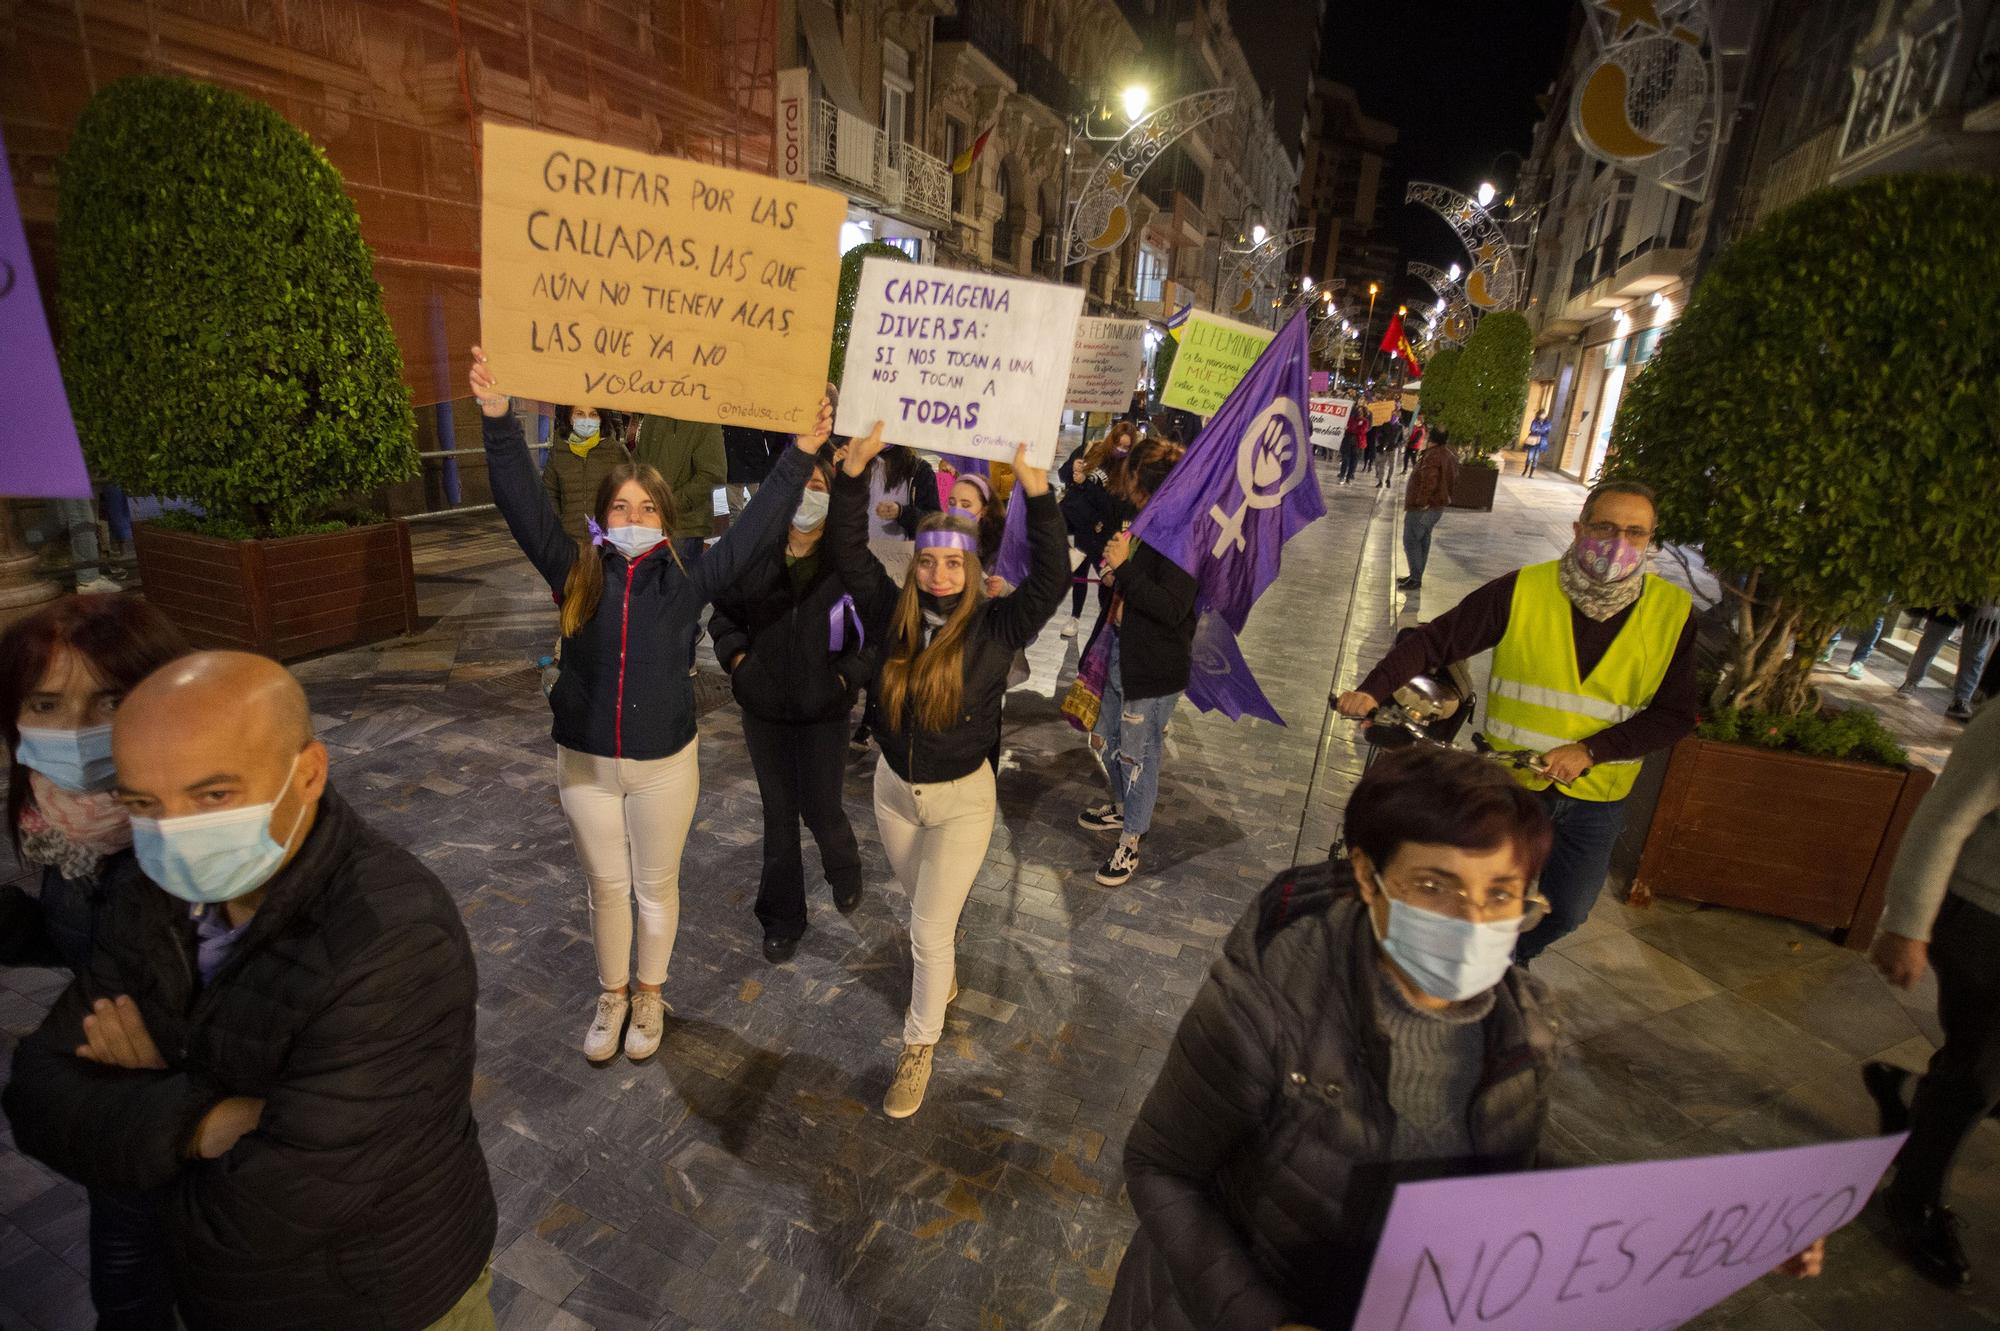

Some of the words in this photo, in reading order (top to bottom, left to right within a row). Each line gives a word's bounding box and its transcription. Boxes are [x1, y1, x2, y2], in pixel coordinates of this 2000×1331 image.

[781, 98, 798, 175] corral
[544, 151, 670, 206] GRITAR
[692, 180, 733, 214] POR
[751, 196, 798, 230] LAS
[709, 244, 753, 282] LAS
[761, 259, 806, 292] QUE
[533, 272, 590, 301] AÚN
[601, 280, 630, 307] NO
[642, 285, 724, 319] TIENEN
[884, 278, 1010, 312] CARTAGENA
[531, 320, 582, 353] LAS
[594, 328, 633, 357] QUE
[650, 334, 674, 360] YA
[693, 343, 726, 368] NO
[877, 312, 988, 340] DIVERSA:
[872, 369, 899, 383] NOS
[920, 371, 963, 389] TOCAN
[983, 379, 996, 396] A
[875, 346, 895, 365] SI
[908, 348, 935, 365] NOS
[948, 350, 988, 370] TOCAN
[991, 357, 1001, 371] A
[1009, 359, 1035, 377] UNA
[899, 397, 981, 430] TODAS
[1397, 1231, 1542, 1326] NO
[1556, 1216, 1650, 1302] ES
[1644, 1185, 1857, 1284] ABUSO
